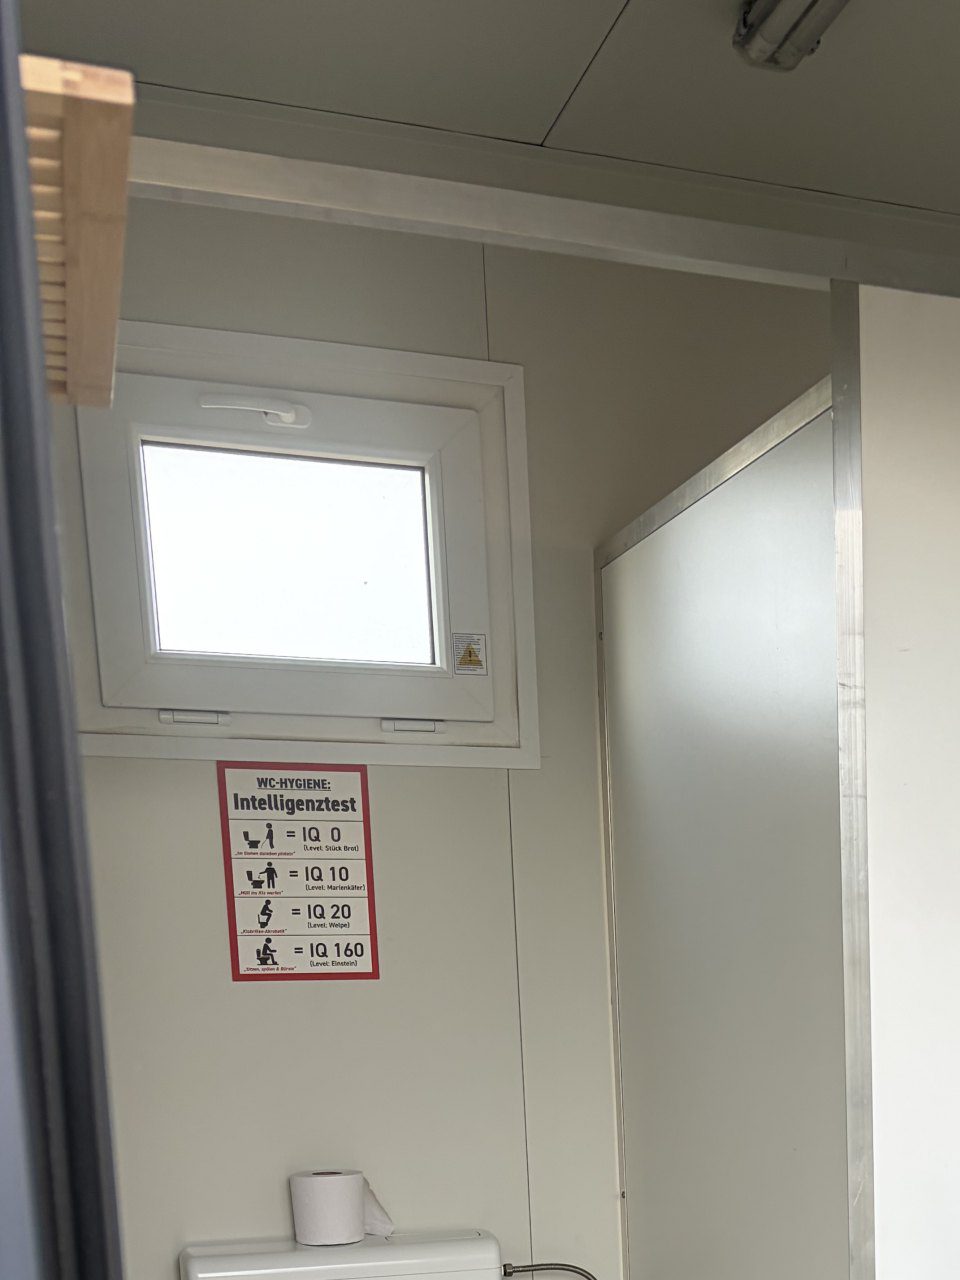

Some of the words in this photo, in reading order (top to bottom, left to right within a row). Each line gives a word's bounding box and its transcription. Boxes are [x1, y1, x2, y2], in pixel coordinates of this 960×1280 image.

[256, 777, 331, 790] WC-HYGIENE:
[233, 793, 357, 816] Intelligenztest
[302, 826, 321, 843] IQ
[330, 826, 341, 843] 0
[305, 866, 324, 882] IQ
[329, 866, 349, 882] 10
[307, 904, 326, 920] IQ
[331, 904, 352, 920] 20
[310, 942, 329, 959] IQ
[334, 942, 364, 958] 160
